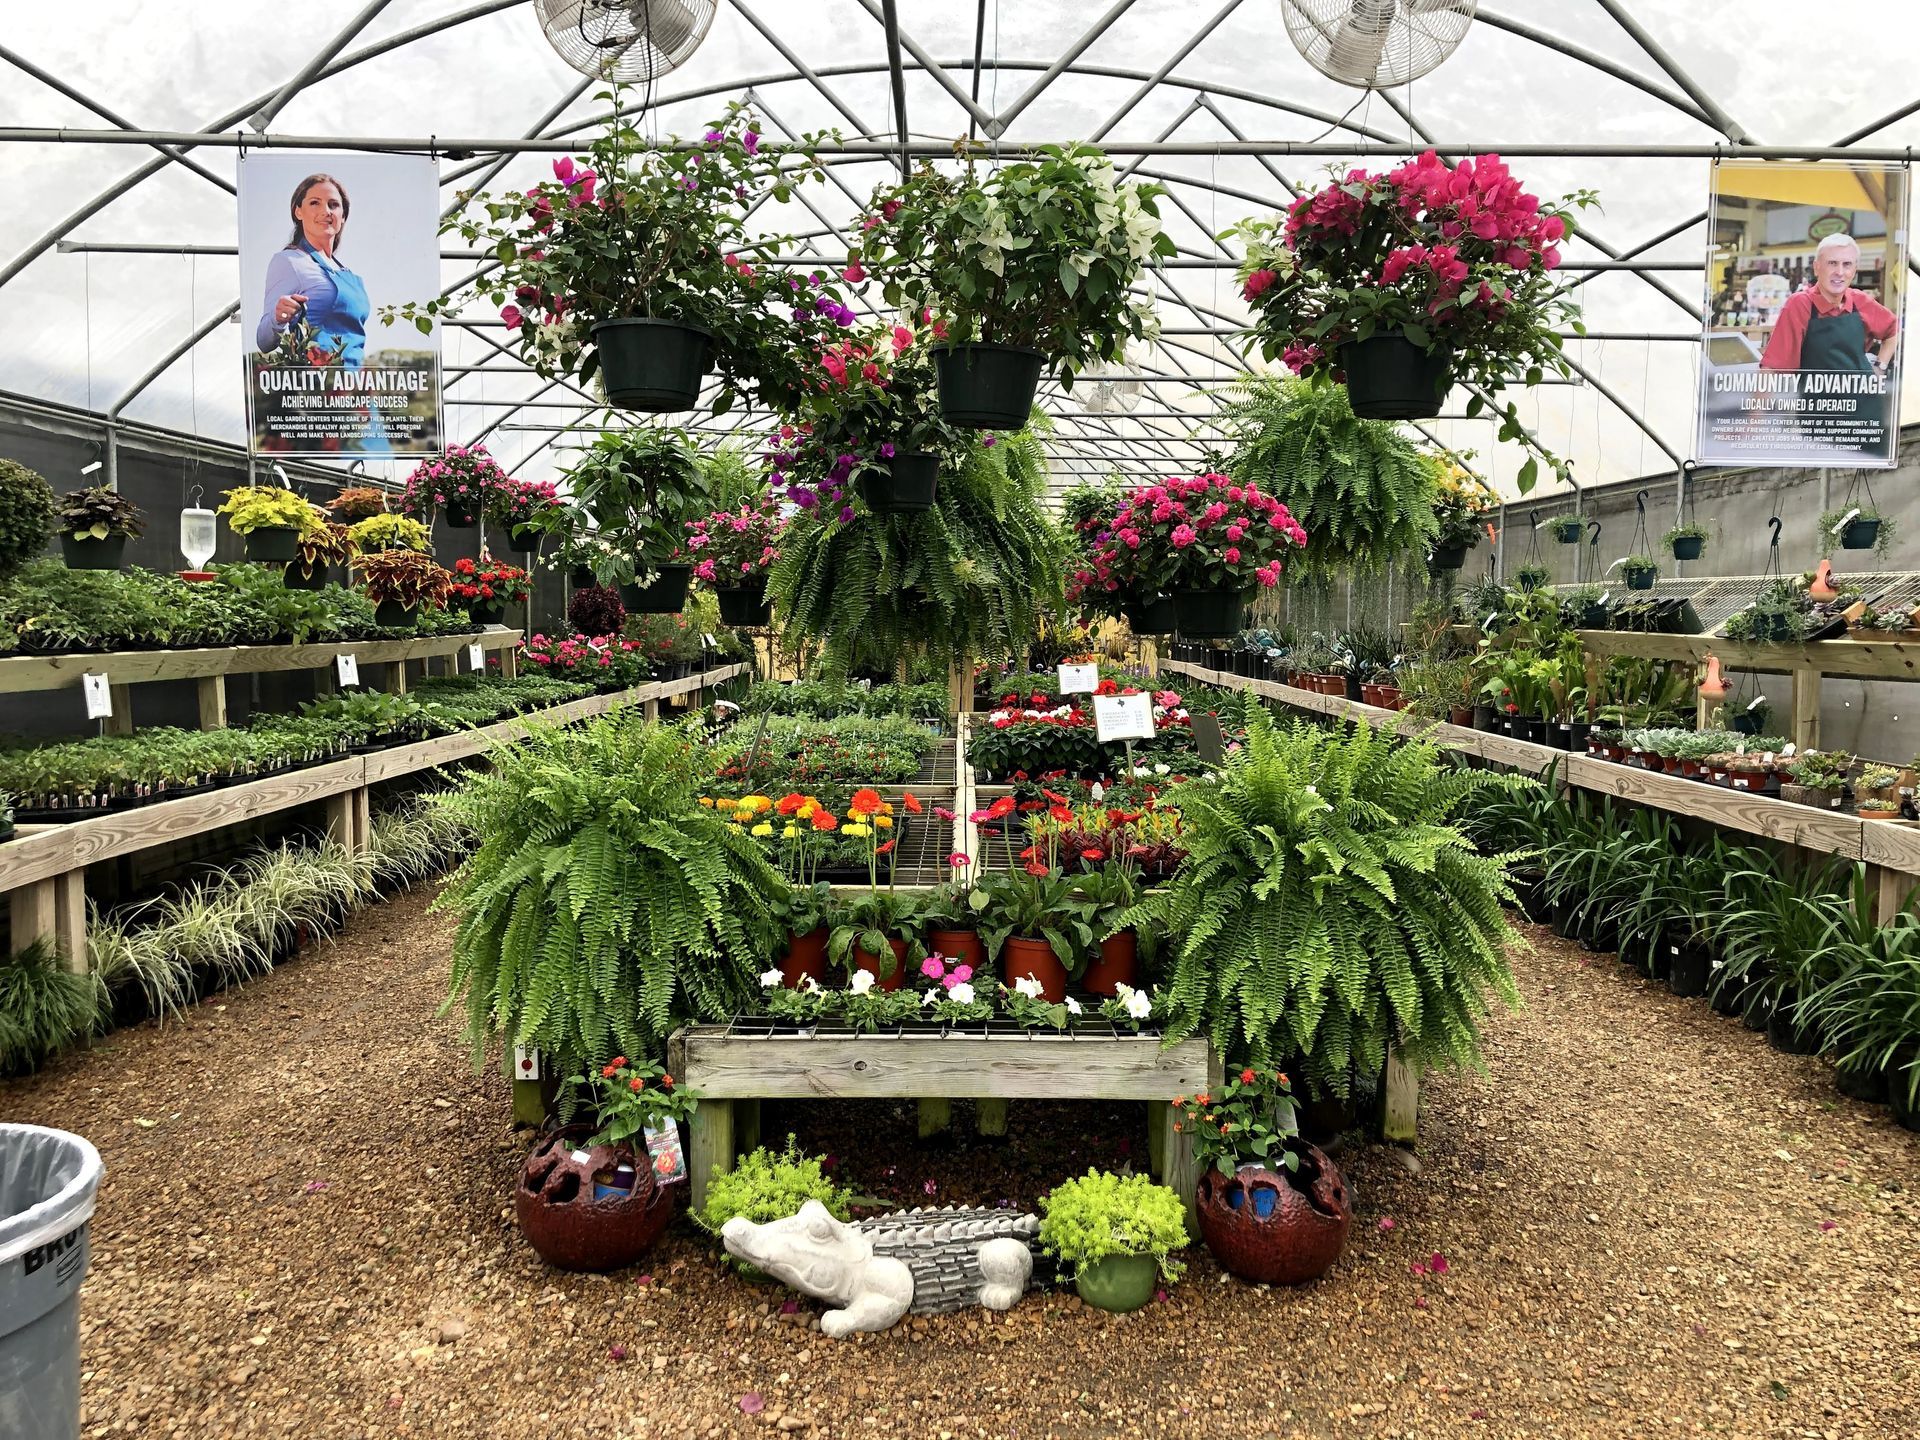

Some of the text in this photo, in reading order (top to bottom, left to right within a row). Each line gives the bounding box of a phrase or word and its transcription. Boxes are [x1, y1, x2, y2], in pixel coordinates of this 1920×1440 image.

[259, 370, 429, 394] QUALITY ADVANTAGE
[1713, 372, 1888, 394] COMMUNITY ADVANTAGE
[281, 395, 409, 408] ACHIEVING LANDSCAPE SUCCESS
[1741, 398, 1857, 412] LOCALLY OWNED & OPERATED
